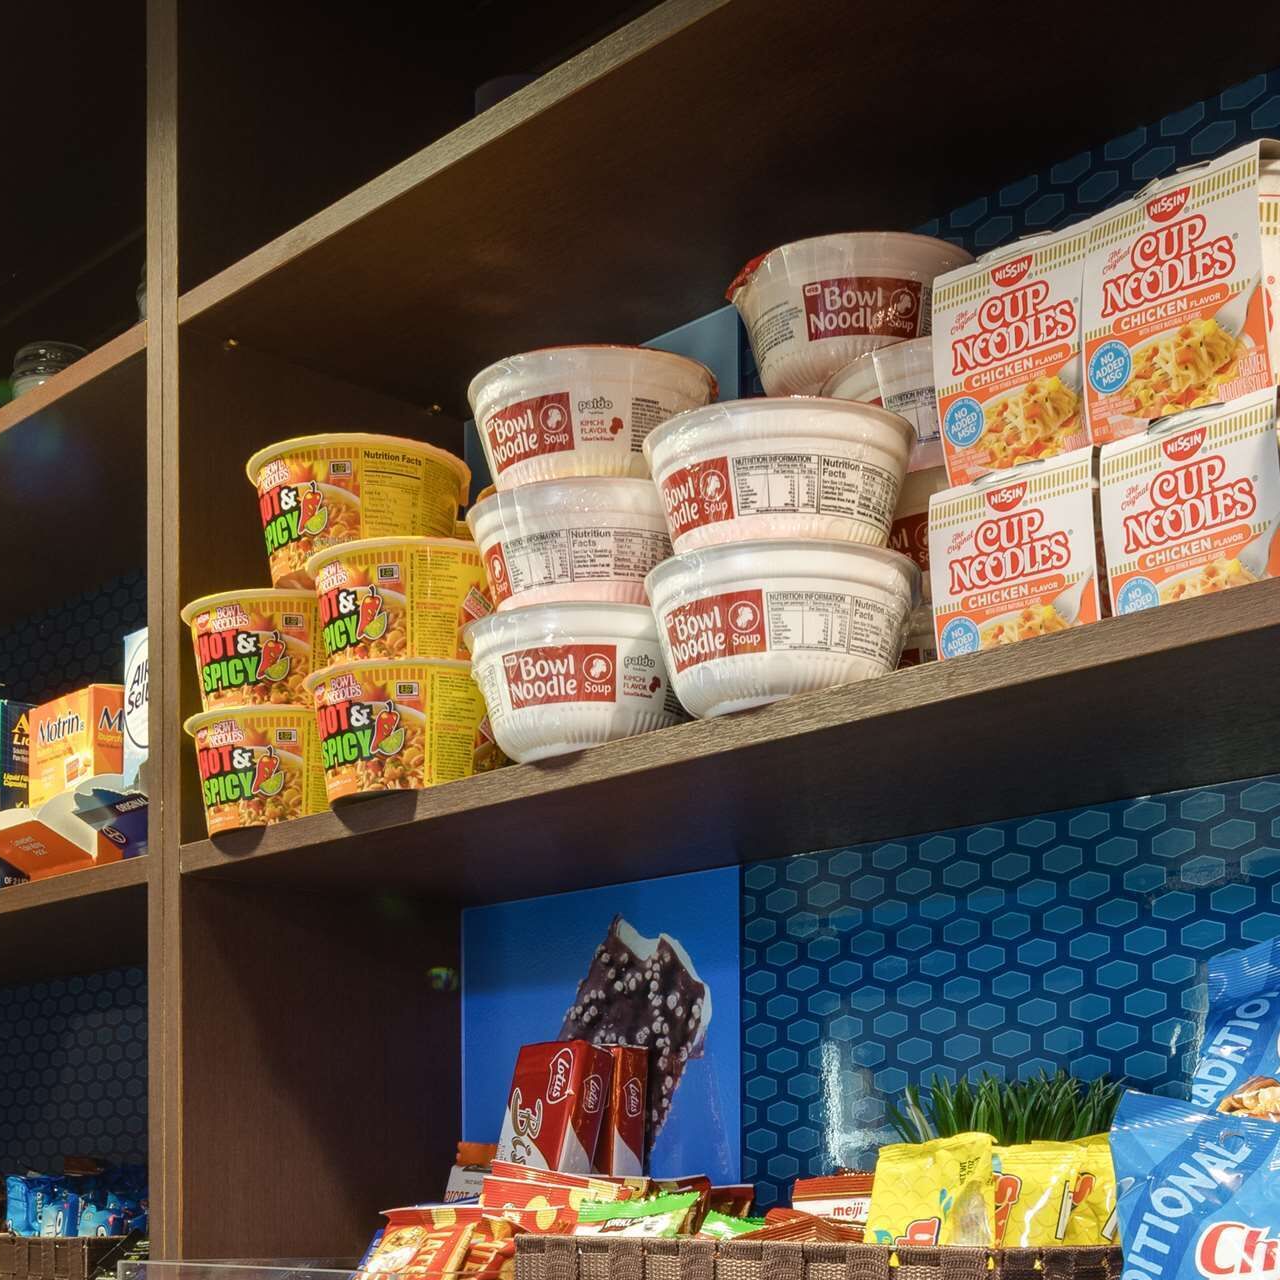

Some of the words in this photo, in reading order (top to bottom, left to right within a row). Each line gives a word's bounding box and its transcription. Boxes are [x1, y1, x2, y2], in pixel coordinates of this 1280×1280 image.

[1130, 213, 1207, 270] CUP
[1101, 235, 1236, 319] NOODLES
[824, 286, 883, 311] Bowl
[978, 280, 1049, 330] CUP
[1119, 297, 1188, 332] CHICKEN
[1189, 292, 1221, 308] FLAVOR
[952, 299, 1077, 376] NOODLES
[971, 357, 1034, 388] CHICKEN
[1034, 352, 1063, 366] FLAVOR
[950, 413, 978, 432] ADDED
[954, 409, 967, 421] NO
[957, 423, 976, 440] MSG
[363, 450, 400, 462] Nutrition
[401, 456, 422, 466] Facts
[492, 429, 539, 468] Noodle
[544, 432, 569, 447] Soup
[823, 457, 860, 472] Nutrition
[822, 467, 847, 479] Facts
[1150, 455, 1226, 507] CUP
[990, 487, 1024, 506] NISSIN
[1124, 473, 1258, 555] NOODLES
[949, 529, 1071, 596] NOODLES
[968, 585, 1031, 609] CHICKEN
[1031, 581, 1059, 595] FLAVOR
[215, 604, 244, 620] BOWL
[197, 630, 238, 664] HOT
[237, 634, 257, 653] &
[672, 631, 725, 666] Noodle
[732, 632, 761, 646] Soup
[947, 634, 973, 651] ADDED
[202, 656, 258, 692] SPICY
[520, 654, 576, 681] Bowl
[511, 676, 577, 702] Noodle
[584, 682, 612, 694] Soup
[38, 712, 80, 745] Motrin
[203, 773, 254, 806] SPICY
[833, 1201, 864, 1217] meiji
